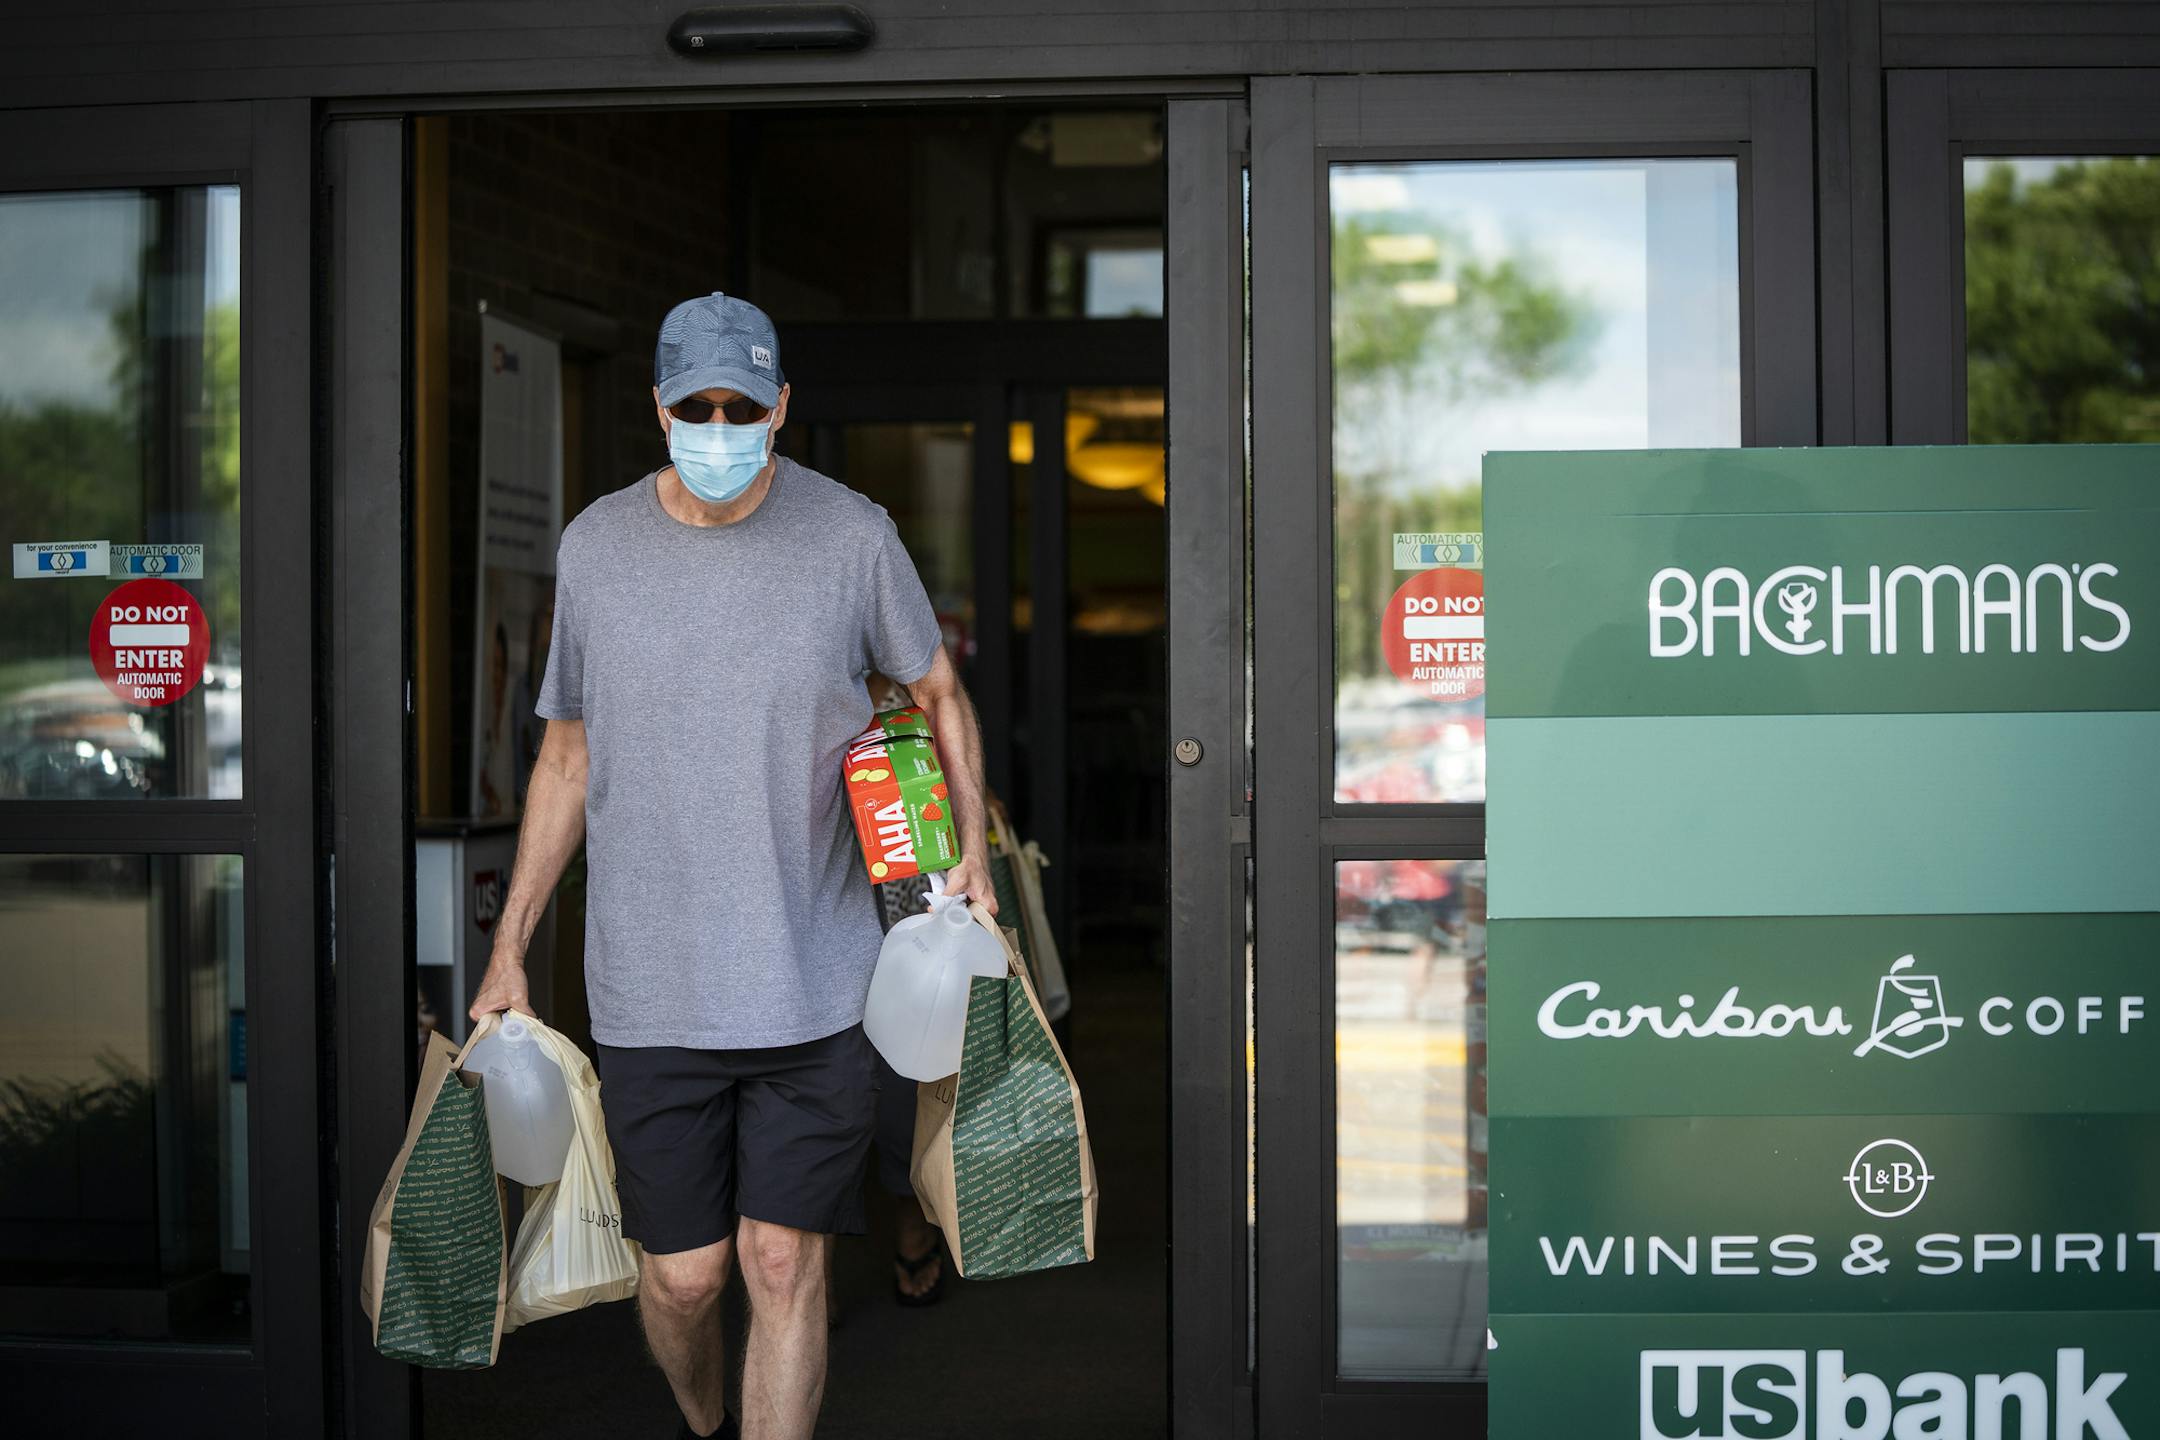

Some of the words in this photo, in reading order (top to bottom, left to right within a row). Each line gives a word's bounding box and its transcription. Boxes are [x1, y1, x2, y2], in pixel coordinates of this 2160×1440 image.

[38, 544, 53, 552] your
[54, 542, 97, 551] convenience
[1397, 534, 1463, 545] AUTOMATIC
[110, 546, 168, 556] AUTOMATIC
[171, 545, 201, 555] DOOR
[1405, 597, 1438, 614] DO
[1648, 562, 2131, 658] BACHMAN'S
[111, 606, 141, 622] DO
[146, 606, 188, 622] NOT
[115, 650, 184, 668] ENTER
[1410, 642, 1486, 662] ENTER
[117, 672, 182, 685] AUTOMATIC
[1412, 666, 1484, 680] AUTOMATIC
[134, 687, 165, 699] DOOR
[1432, 682, 1466, 695] DOOR
[874, 799, 916, 863] AHA
[1537, 981, 1852, 1040] Caribou
[1978, 995, 2145, 1036] COFF
[1862, 1161, 1916, 1195] L&B
[1539, 1235, 1818, 1276] WINES
[1841, 1233, 1891, 1276] &
[1916, 1232, 2160, 1274] SPIRIT
